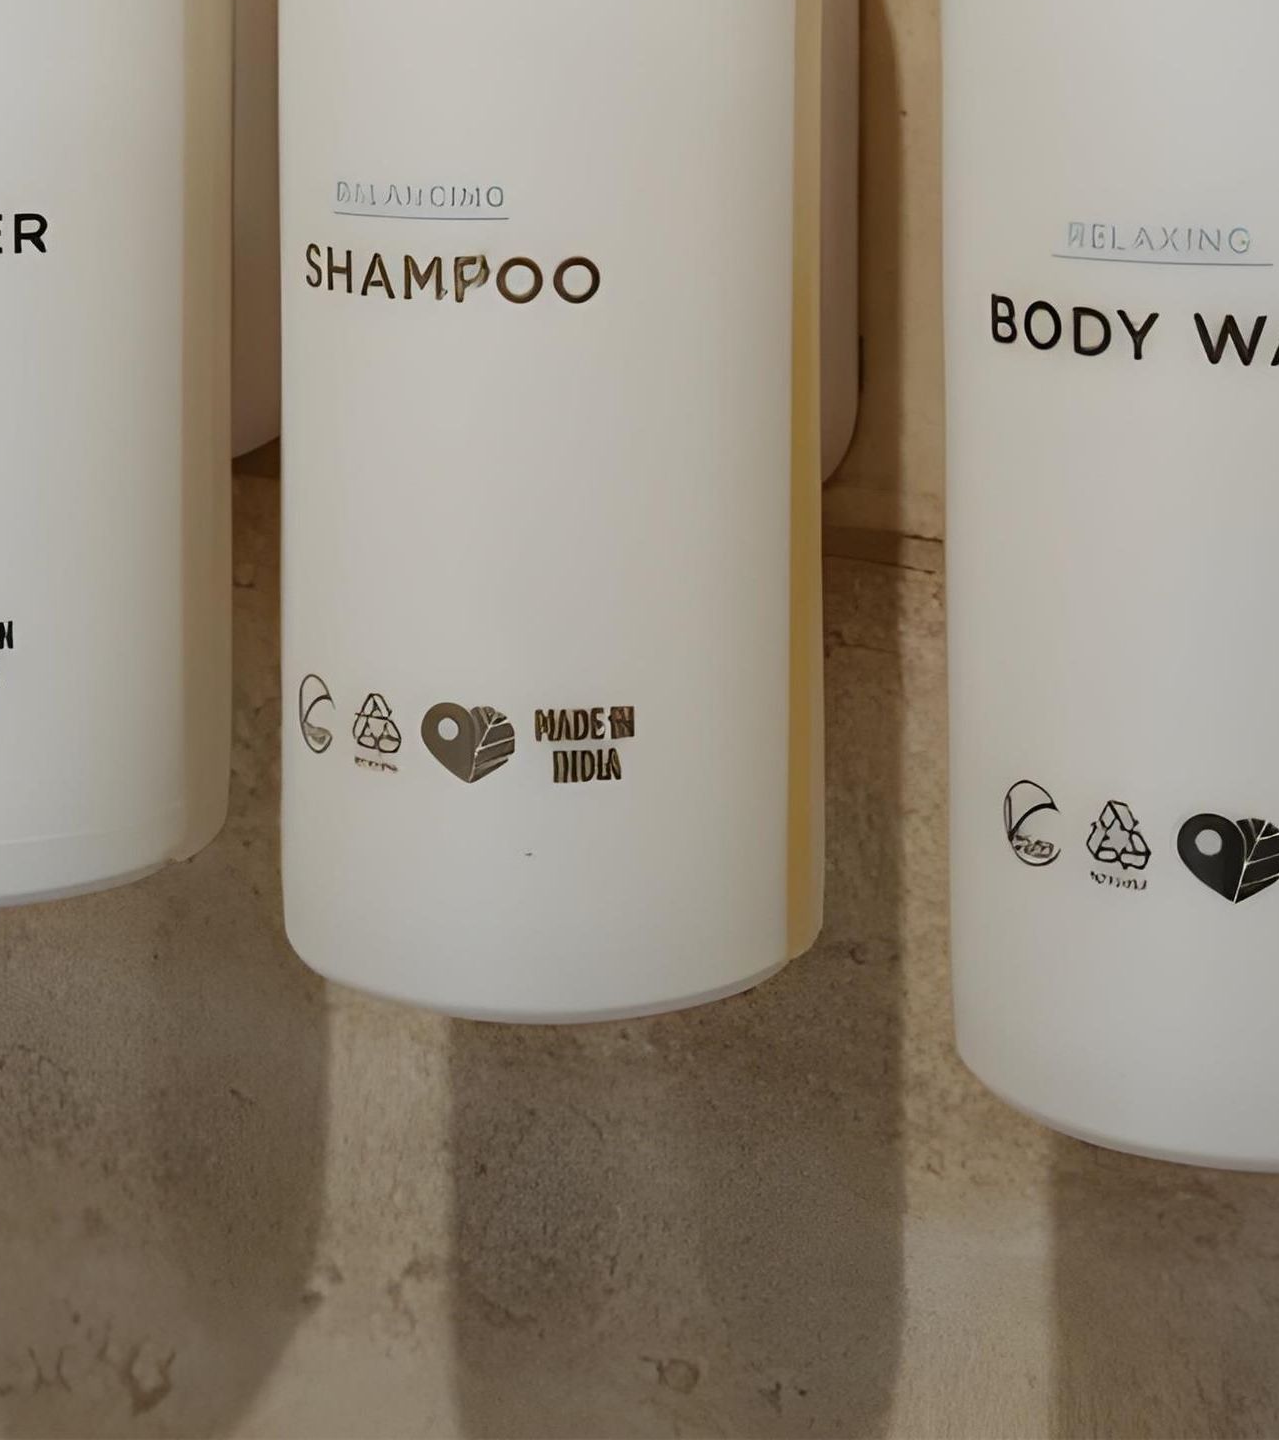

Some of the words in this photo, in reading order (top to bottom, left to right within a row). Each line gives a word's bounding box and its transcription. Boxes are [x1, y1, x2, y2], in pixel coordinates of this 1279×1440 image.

[1067, 221, 1251, 254] RELAXING
[306, 243, 600, 304] SHAMPOO
[991, 294, 1159, 360] BODY
[535, 708, 604, 741] MADE
